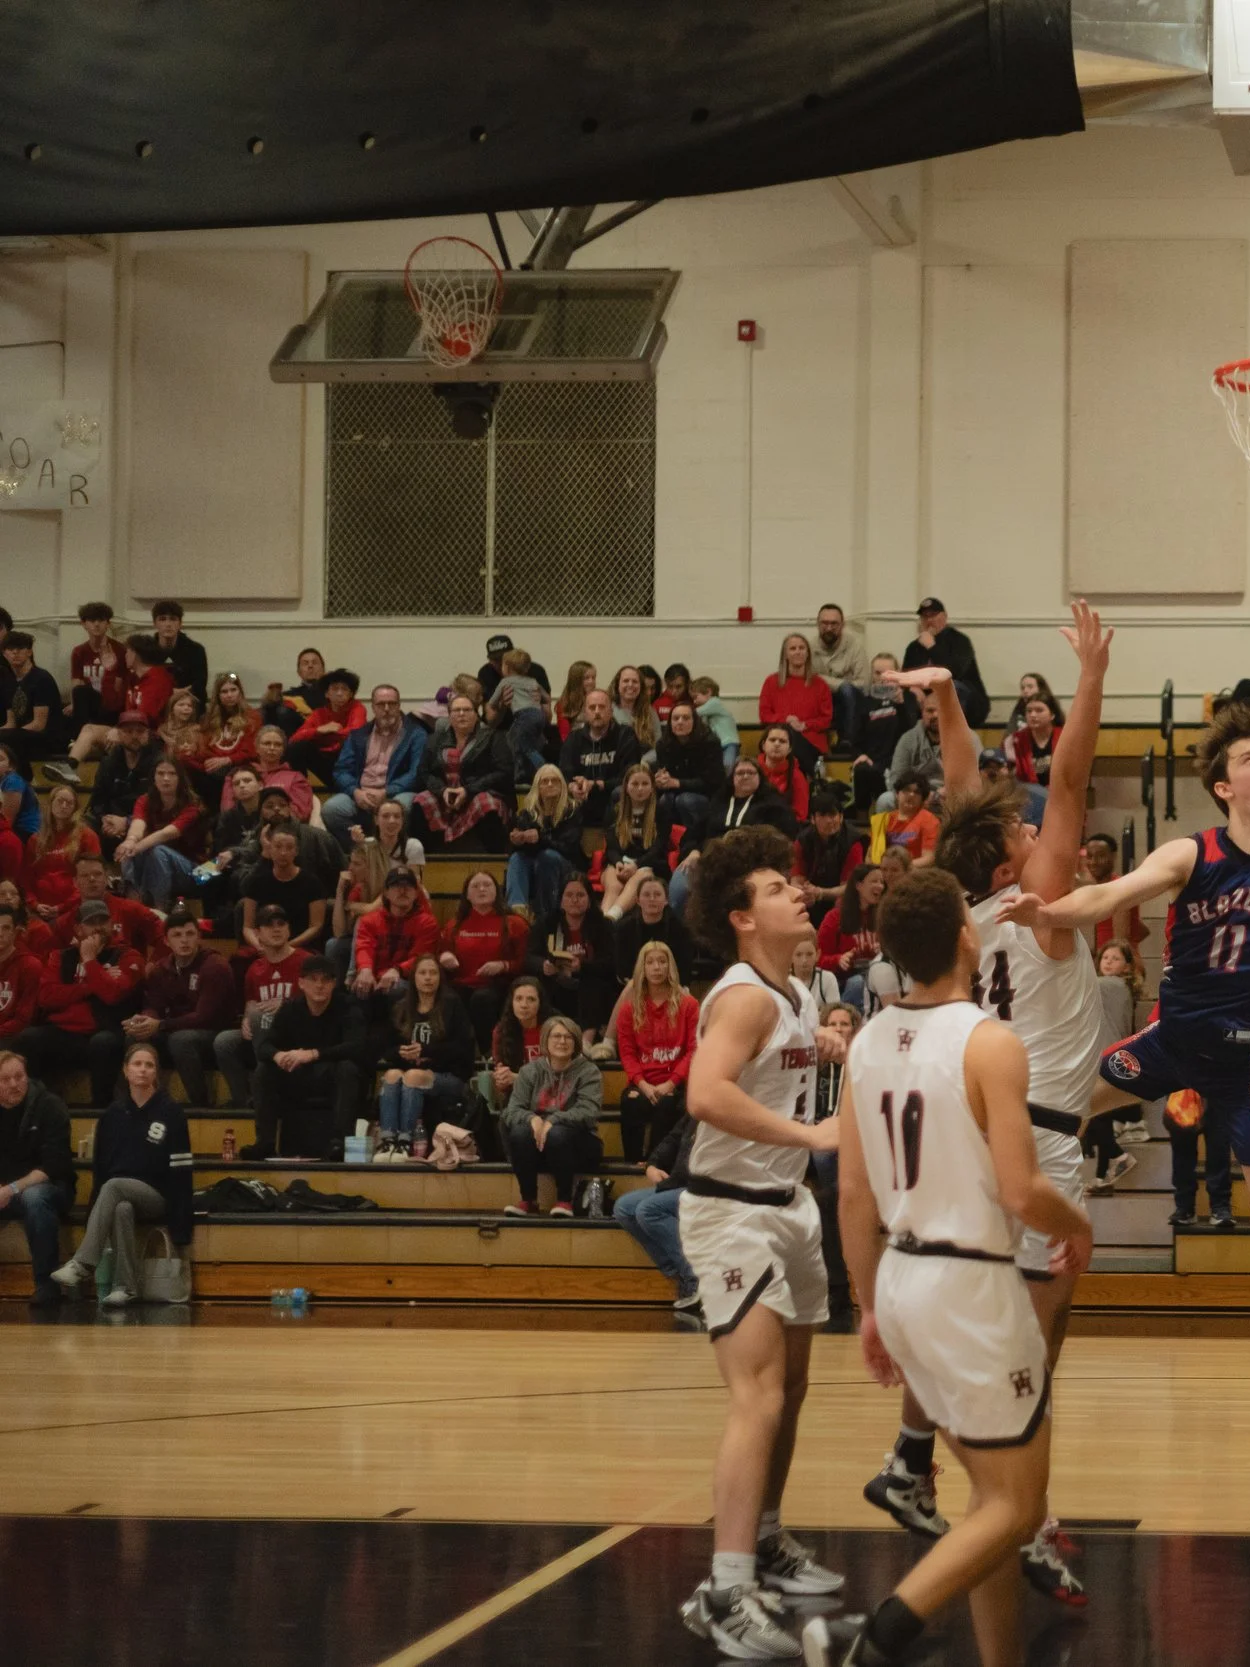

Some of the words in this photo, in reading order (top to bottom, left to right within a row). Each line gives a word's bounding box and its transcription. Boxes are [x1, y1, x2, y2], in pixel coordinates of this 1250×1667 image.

[0, 431, 88, 505] OAR
[1209, 924, 1247, 972] 11
[880, 1088, 925, 1191] 10
